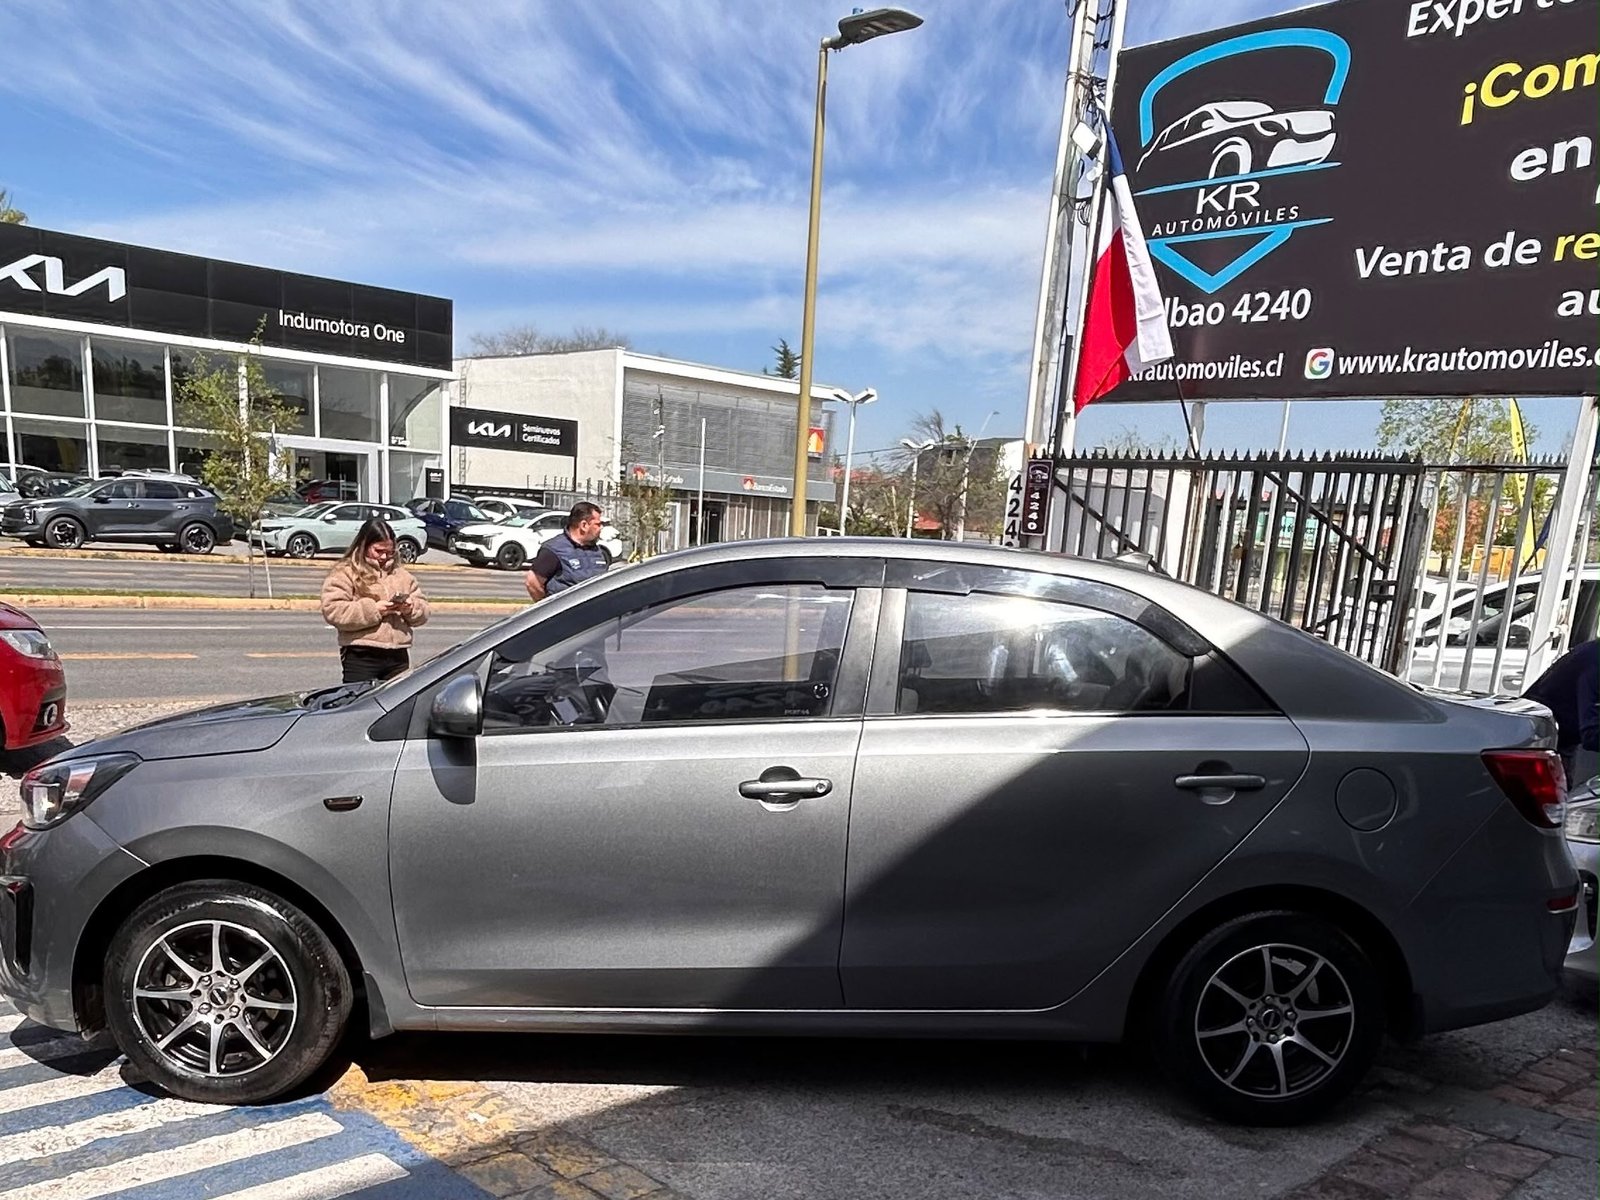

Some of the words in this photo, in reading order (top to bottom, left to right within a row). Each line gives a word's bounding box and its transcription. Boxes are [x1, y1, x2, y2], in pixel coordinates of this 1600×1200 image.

[1407, 0, 1576, 38] Exper
[1460, 52, 1600, 125] ¡Com
[1509, 135, 1592, 182] en
[1195, 181, 1261, 215] KR
[1152, 205, 1300, 237] AUTOMÓVILES
[1354, 242, 1472, 280] Venta
[1483, 231, 1542, 268] de
[1554, 233, 1600, 263] re
[1231, 287, 1312, 324] 4240
[279, 309, 370, 339] Indumotora
[373, 323, 405, 344] One
[1127, 352, 1284, 382] automoviles.cl
[467, 421, 512, 438] KIA
[522, 423, 561, 436] Seminuevos
[522, 433, 561, 446] Certificados
